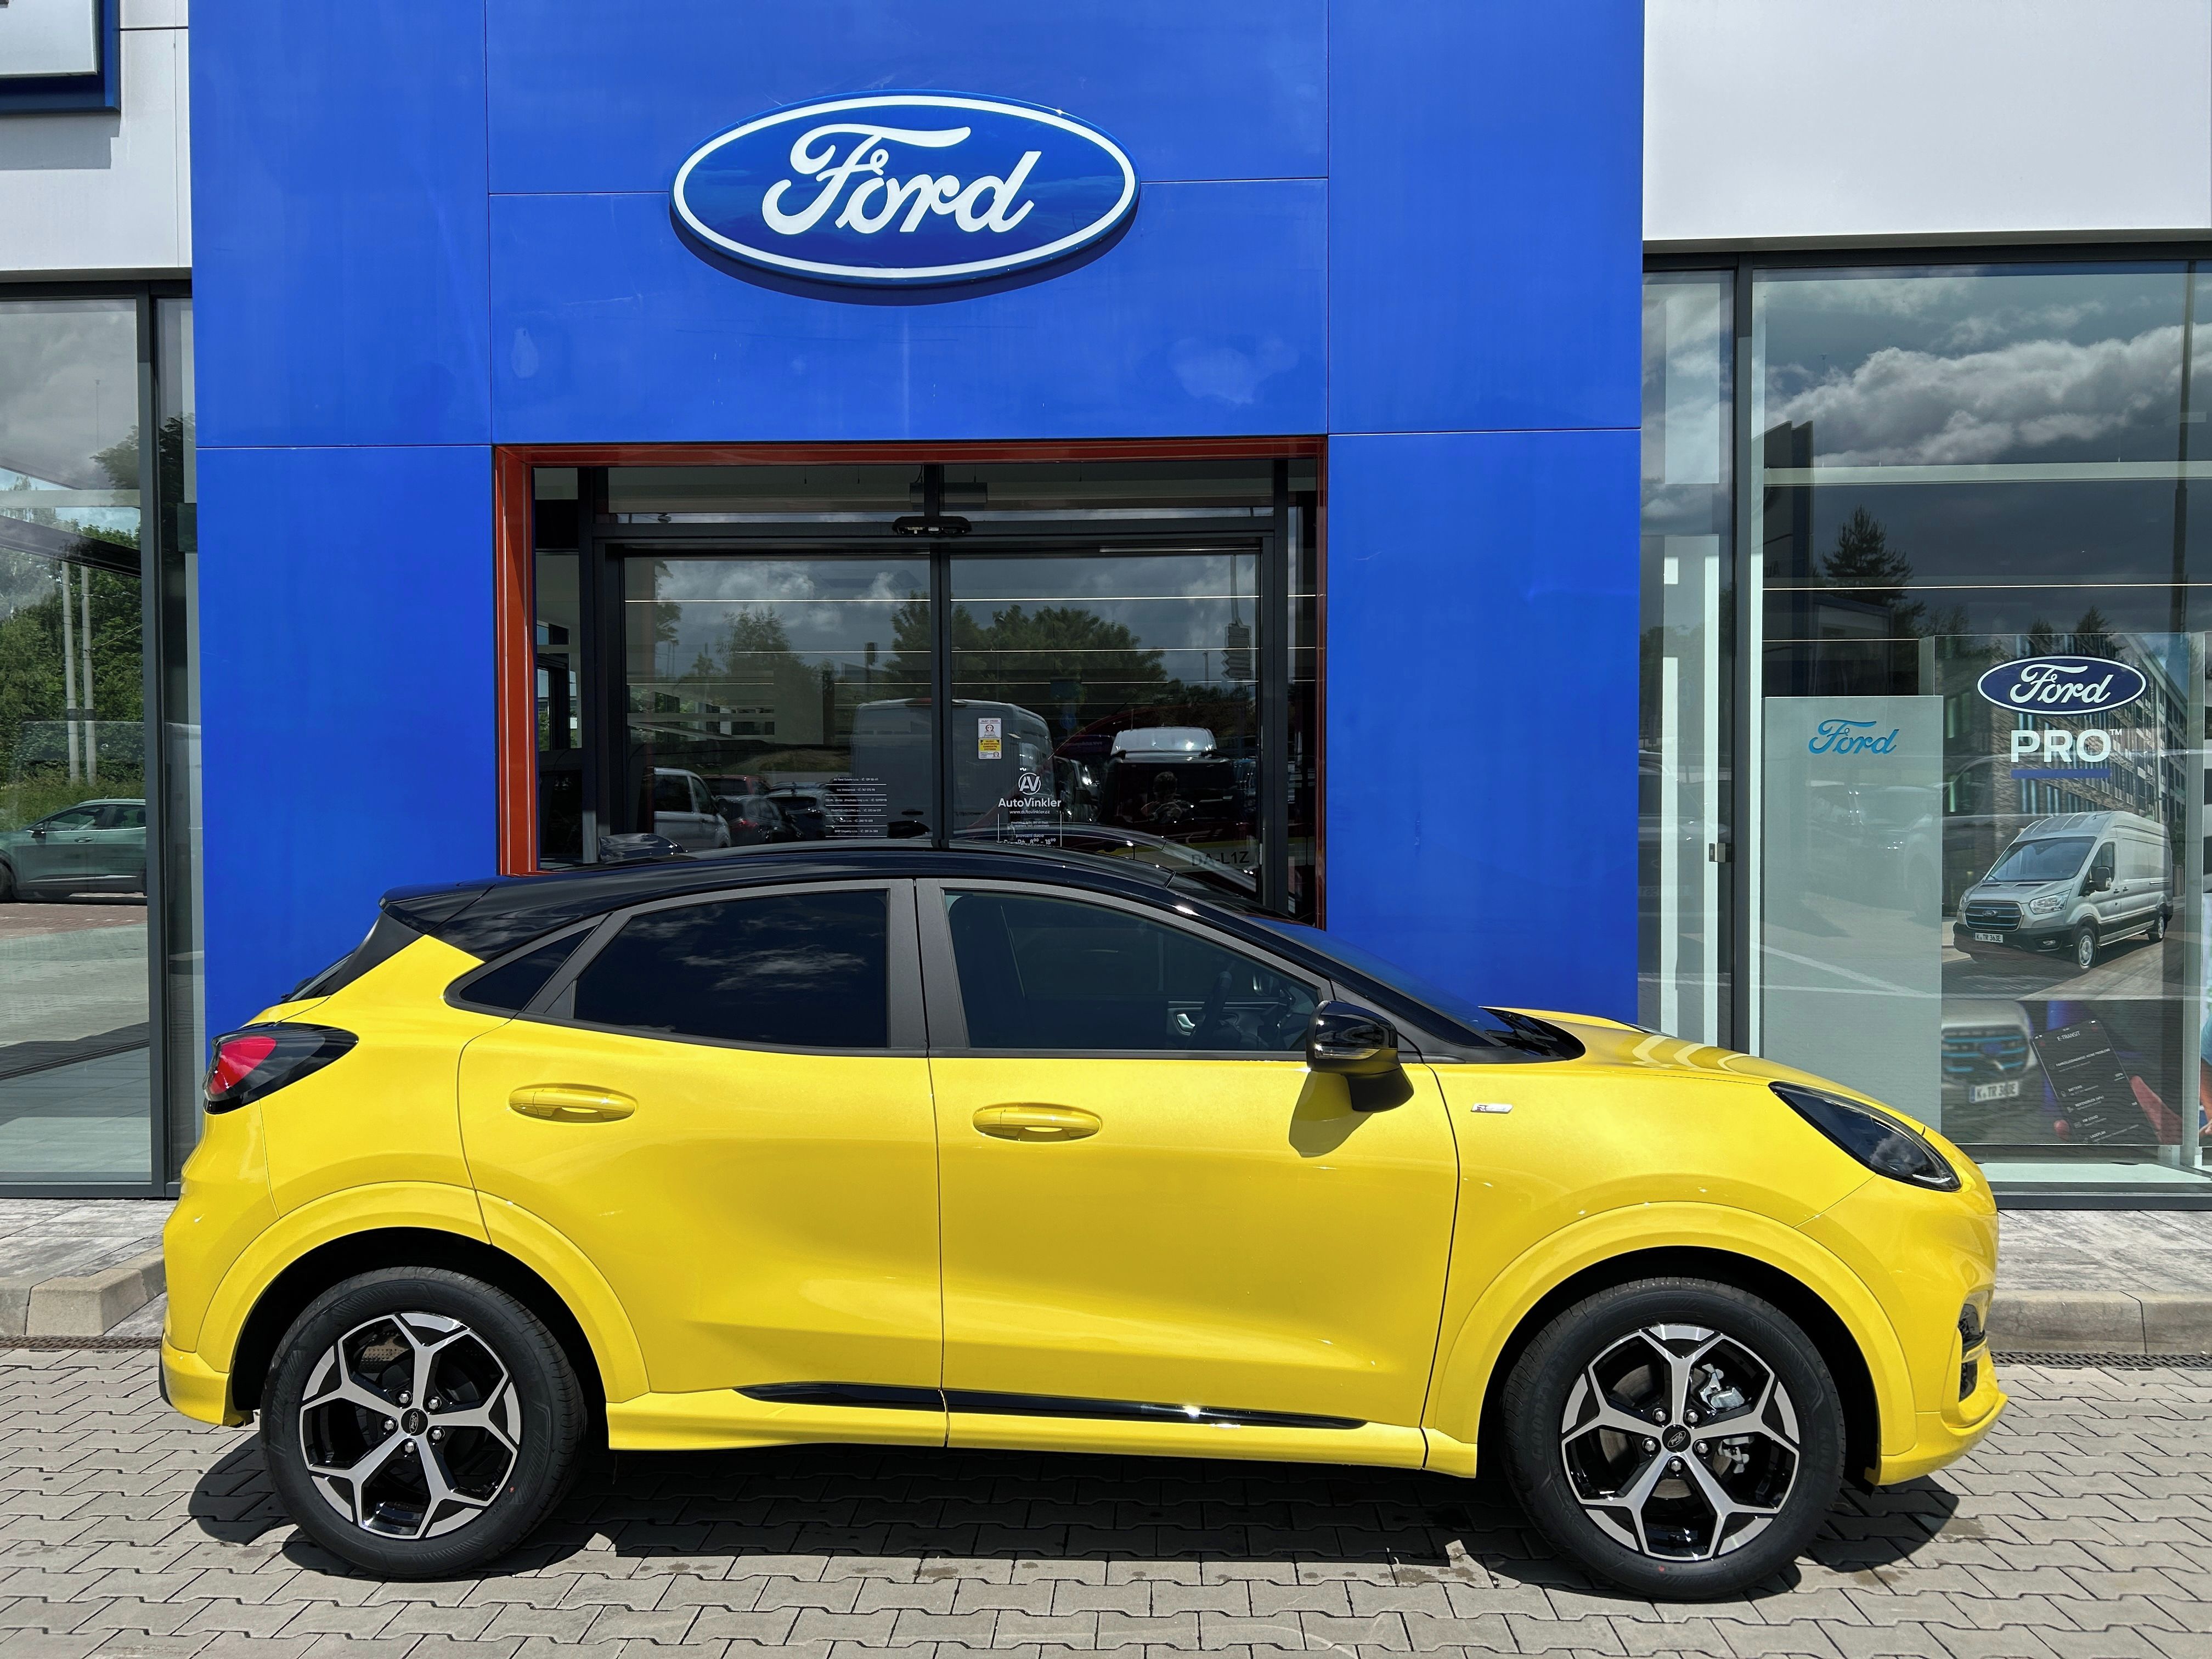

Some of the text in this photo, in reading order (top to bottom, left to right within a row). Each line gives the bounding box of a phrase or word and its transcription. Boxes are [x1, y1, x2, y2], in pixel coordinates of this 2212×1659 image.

[763, 123, 1042, 235] Ford
[2010, 663, 2114, 704] Ford
[1808, 719, 1900, 754] Ford
[1019, 776, 1040, 792] AV
[998, 798, 1062, 808] AutoVinkler
